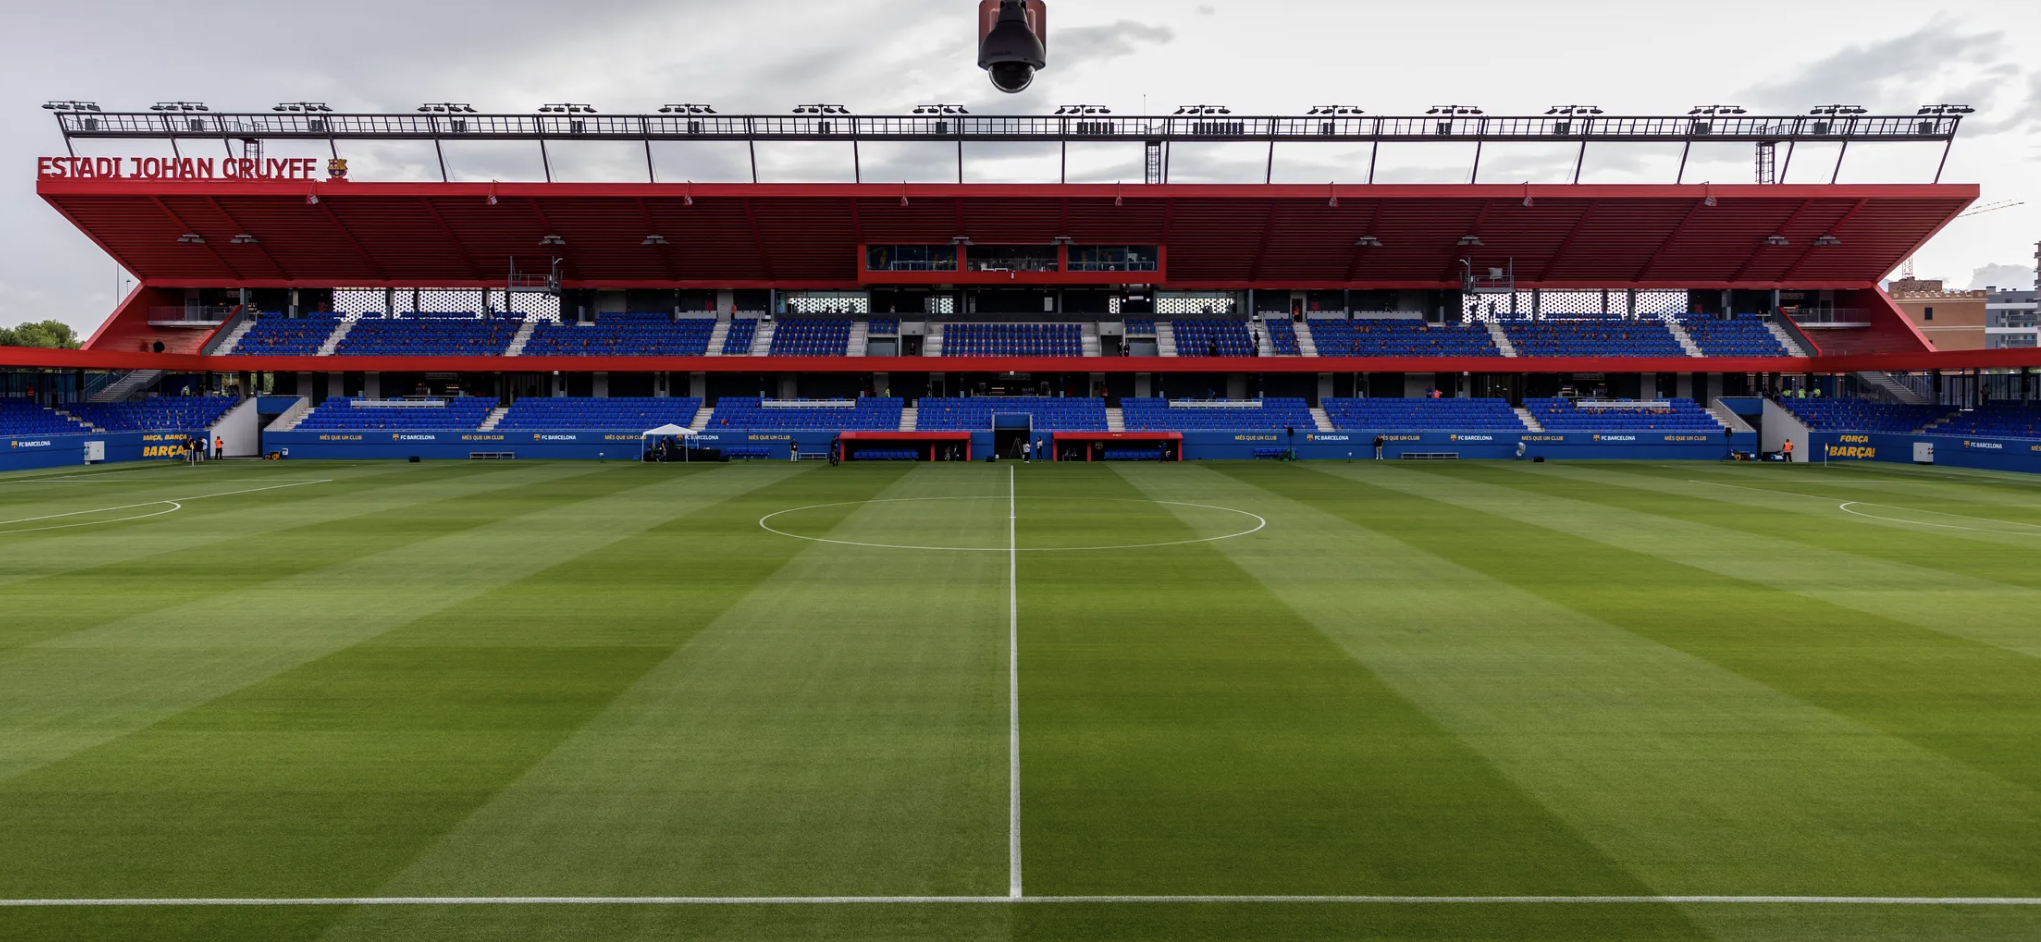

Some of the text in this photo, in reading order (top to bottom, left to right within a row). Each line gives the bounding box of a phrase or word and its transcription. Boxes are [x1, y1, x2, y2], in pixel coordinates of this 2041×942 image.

[38, 157, 317, 180] ESTADI JOHAN CRUYFF
[1840, 435, 1868, 443] FORÇA
[1829, 446, 1876, 458] BARÇA!
